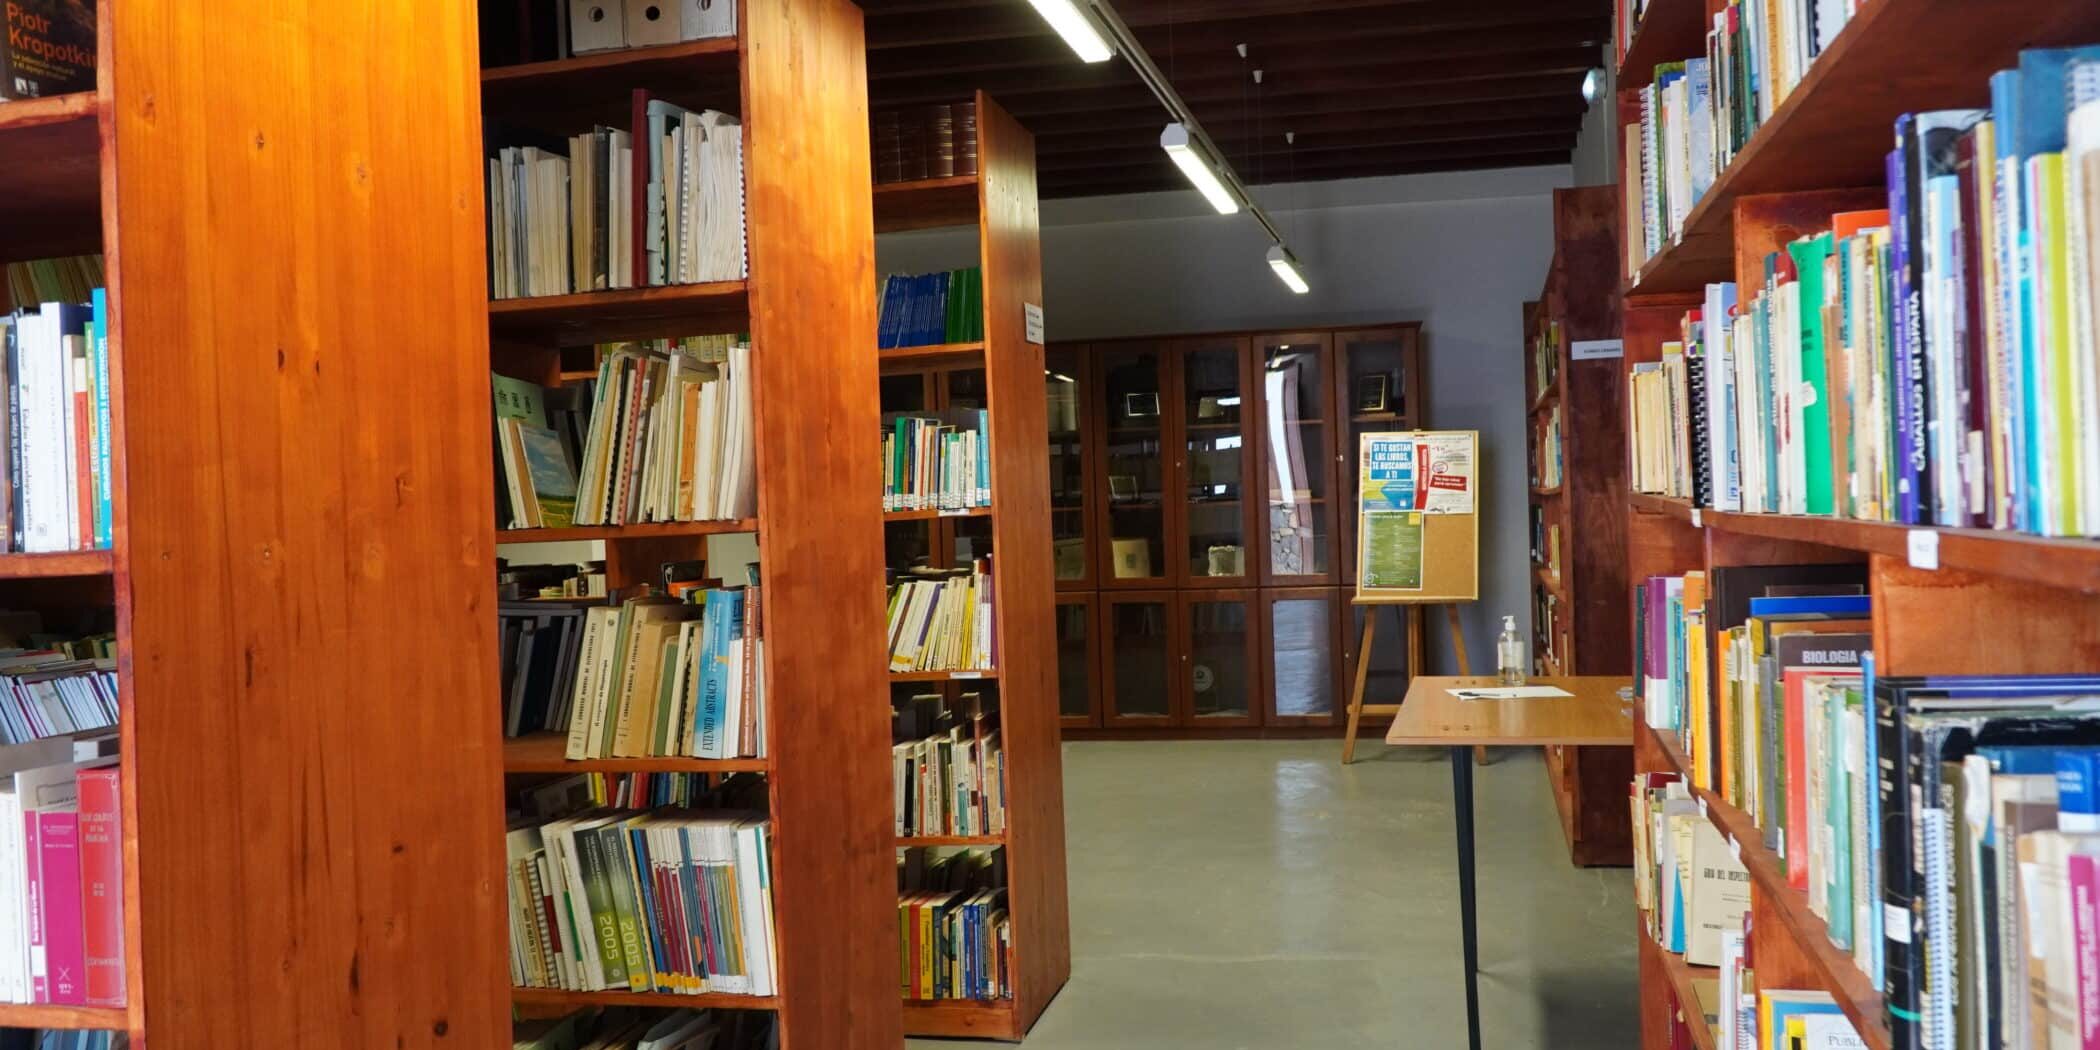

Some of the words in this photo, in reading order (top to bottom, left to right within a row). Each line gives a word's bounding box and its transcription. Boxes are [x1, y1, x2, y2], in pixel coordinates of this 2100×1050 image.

[6, 2, 51, 33] Piotr
[1910, 291, 1922, 354] ESPAÑA
[1911, 359, 1922, 380] EN
[1910, 384, 1926, 472] CABALLOS
[1374, 444, 1380, 452] SI
[1381, 444, 1387, 452] TE
[1388, 443, 1412, 452] GUSTAN
[1373, 462, 1379, 470] TE
[1386, 470, 1390, 478] A
[1391, 470, 1398, 478] TI
[1802, 650, 1858, 664] BIOLOGIA
[704, 679, 718, 714] ABSTRACTS
[702, 717, 714, 750] EXTENDED
[1728, 870, 1750, 882] INSPECTO
[600, 915, 618, 960] 2005
[621, 920, 641, 966] 2005
[1828, 1034, 1862, 1048] PUBLI
